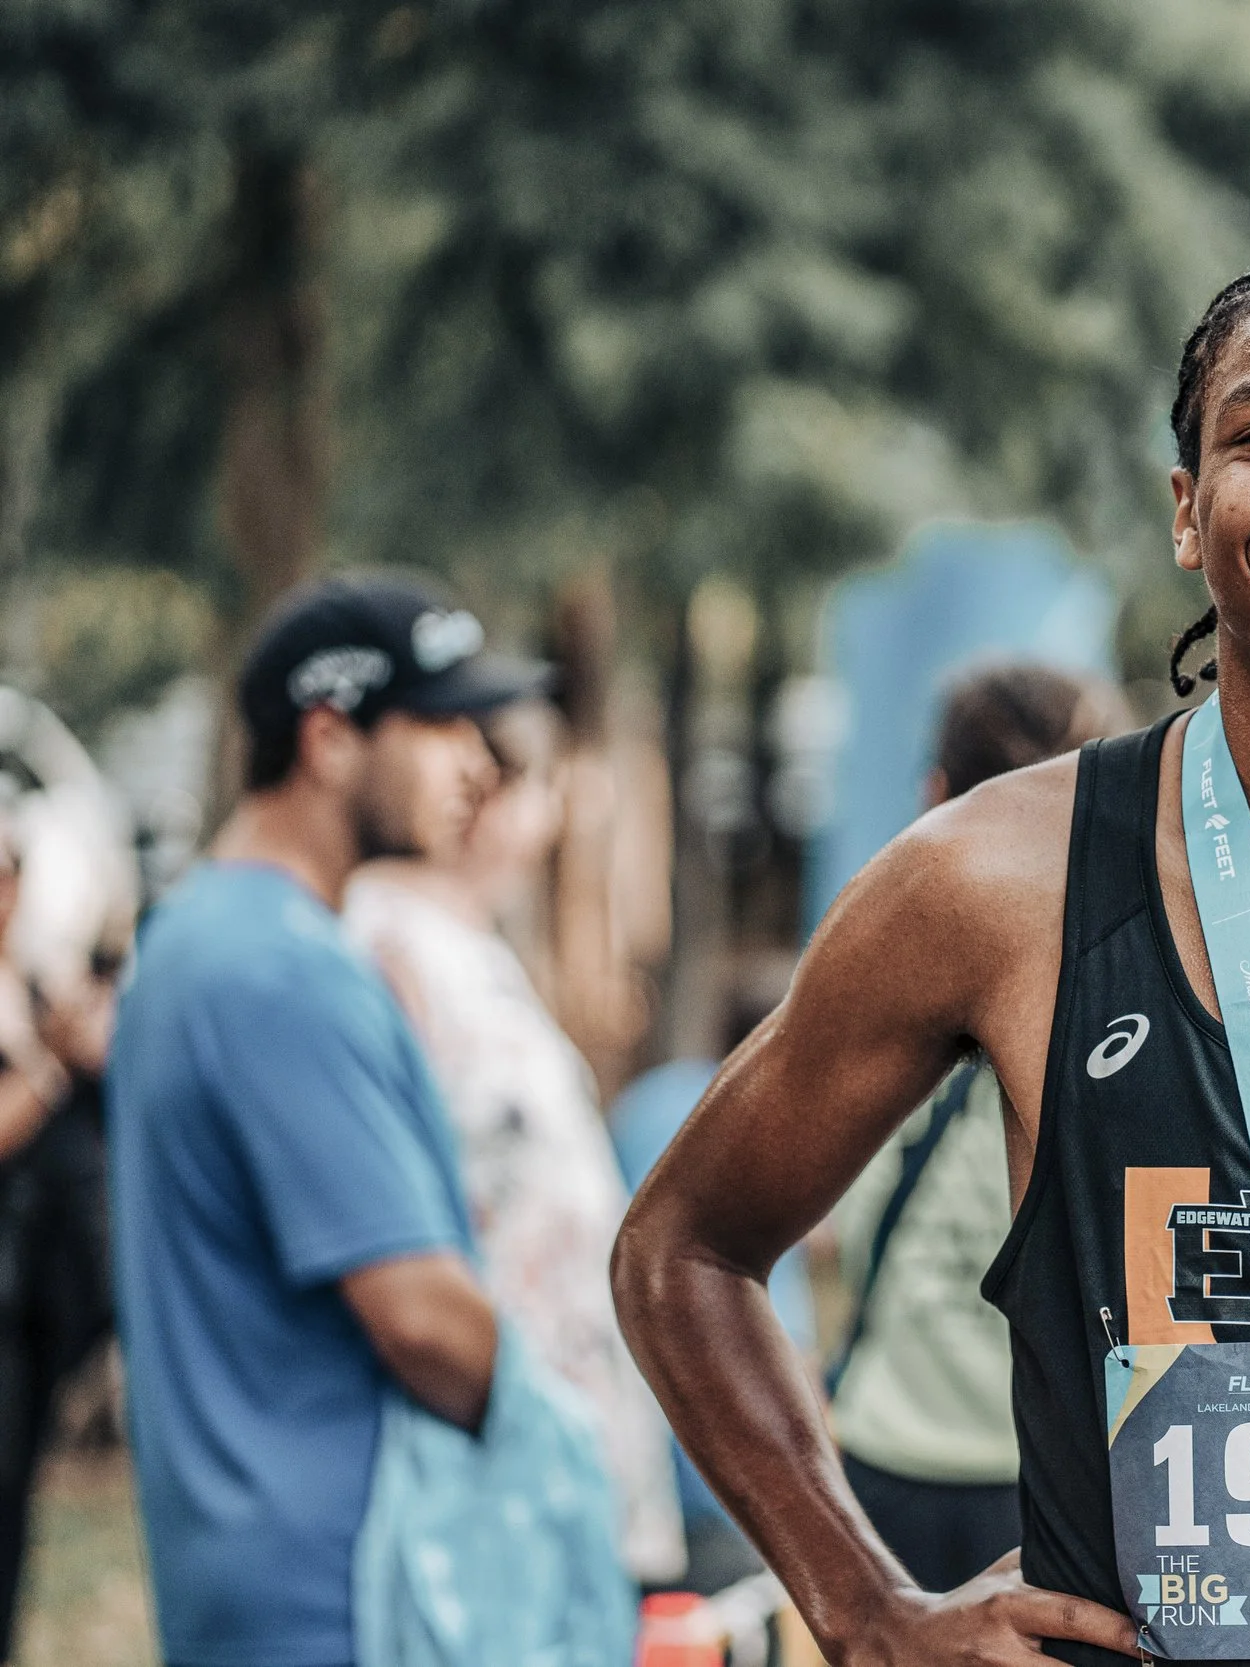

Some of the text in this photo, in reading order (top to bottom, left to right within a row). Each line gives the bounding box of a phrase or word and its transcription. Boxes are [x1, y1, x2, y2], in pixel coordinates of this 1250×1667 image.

[1201, 757, 1218, 809] FLEET
[1156, 1554, 1200, 1573] THE
[1161, 1574, 1228, 1605] BIG
[1161, 1605, 1219, 1627] RUN
